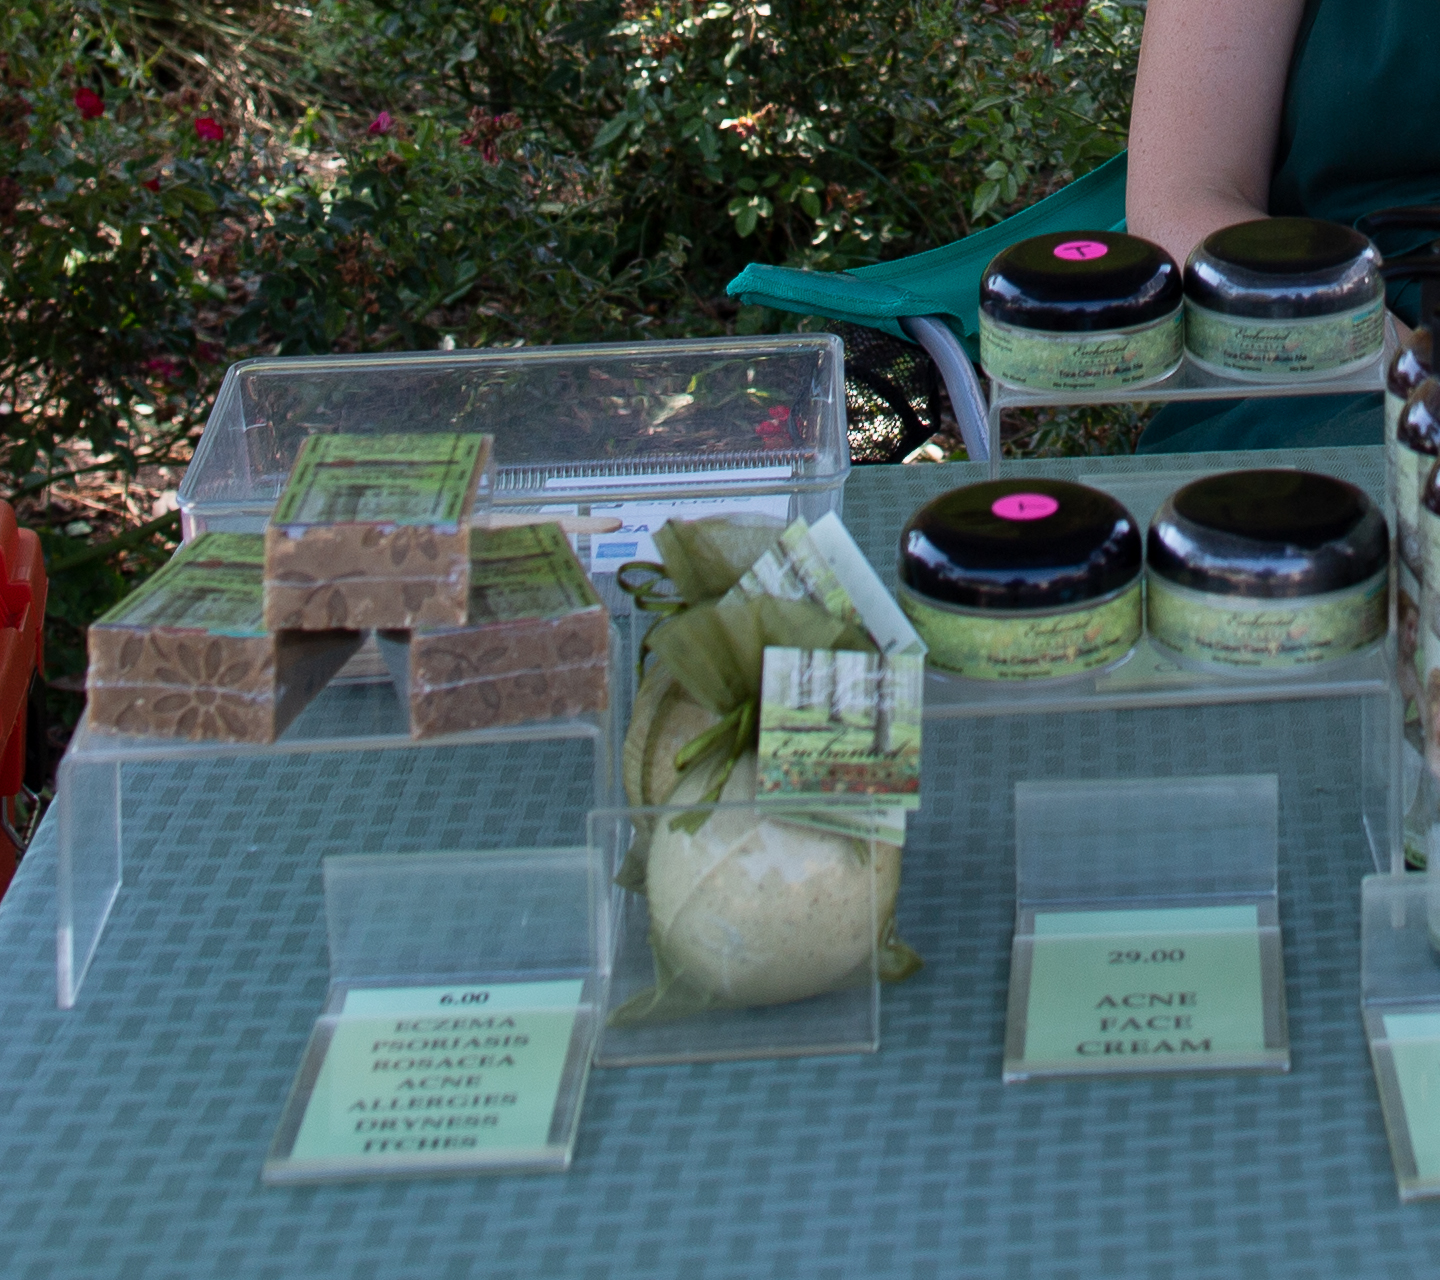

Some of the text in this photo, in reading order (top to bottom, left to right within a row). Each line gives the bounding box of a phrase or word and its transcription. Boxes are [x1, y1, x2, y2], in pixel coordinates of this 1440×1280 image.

[1107, 949, 1185, 965] 29.00
[440, 992, 490, 1005] 6.00
[1095, 992, 1197, 1009] ACNE
[394, 1017, 516, 1033] ECZEMA
[1100, 1015, 1192, 1031] FACE
[372, 1034, 529, 1053] PSORIASIS
[1076, 1038, 1212, 1055] CREAM
[372, 1055, 516, 1072] ROSACEA
[398, 1075, 482, 1089] ACNE
[348, 1092, 518, 1112] ALLERGIES
[354, 1114, 499, 1132] DRYNESS
